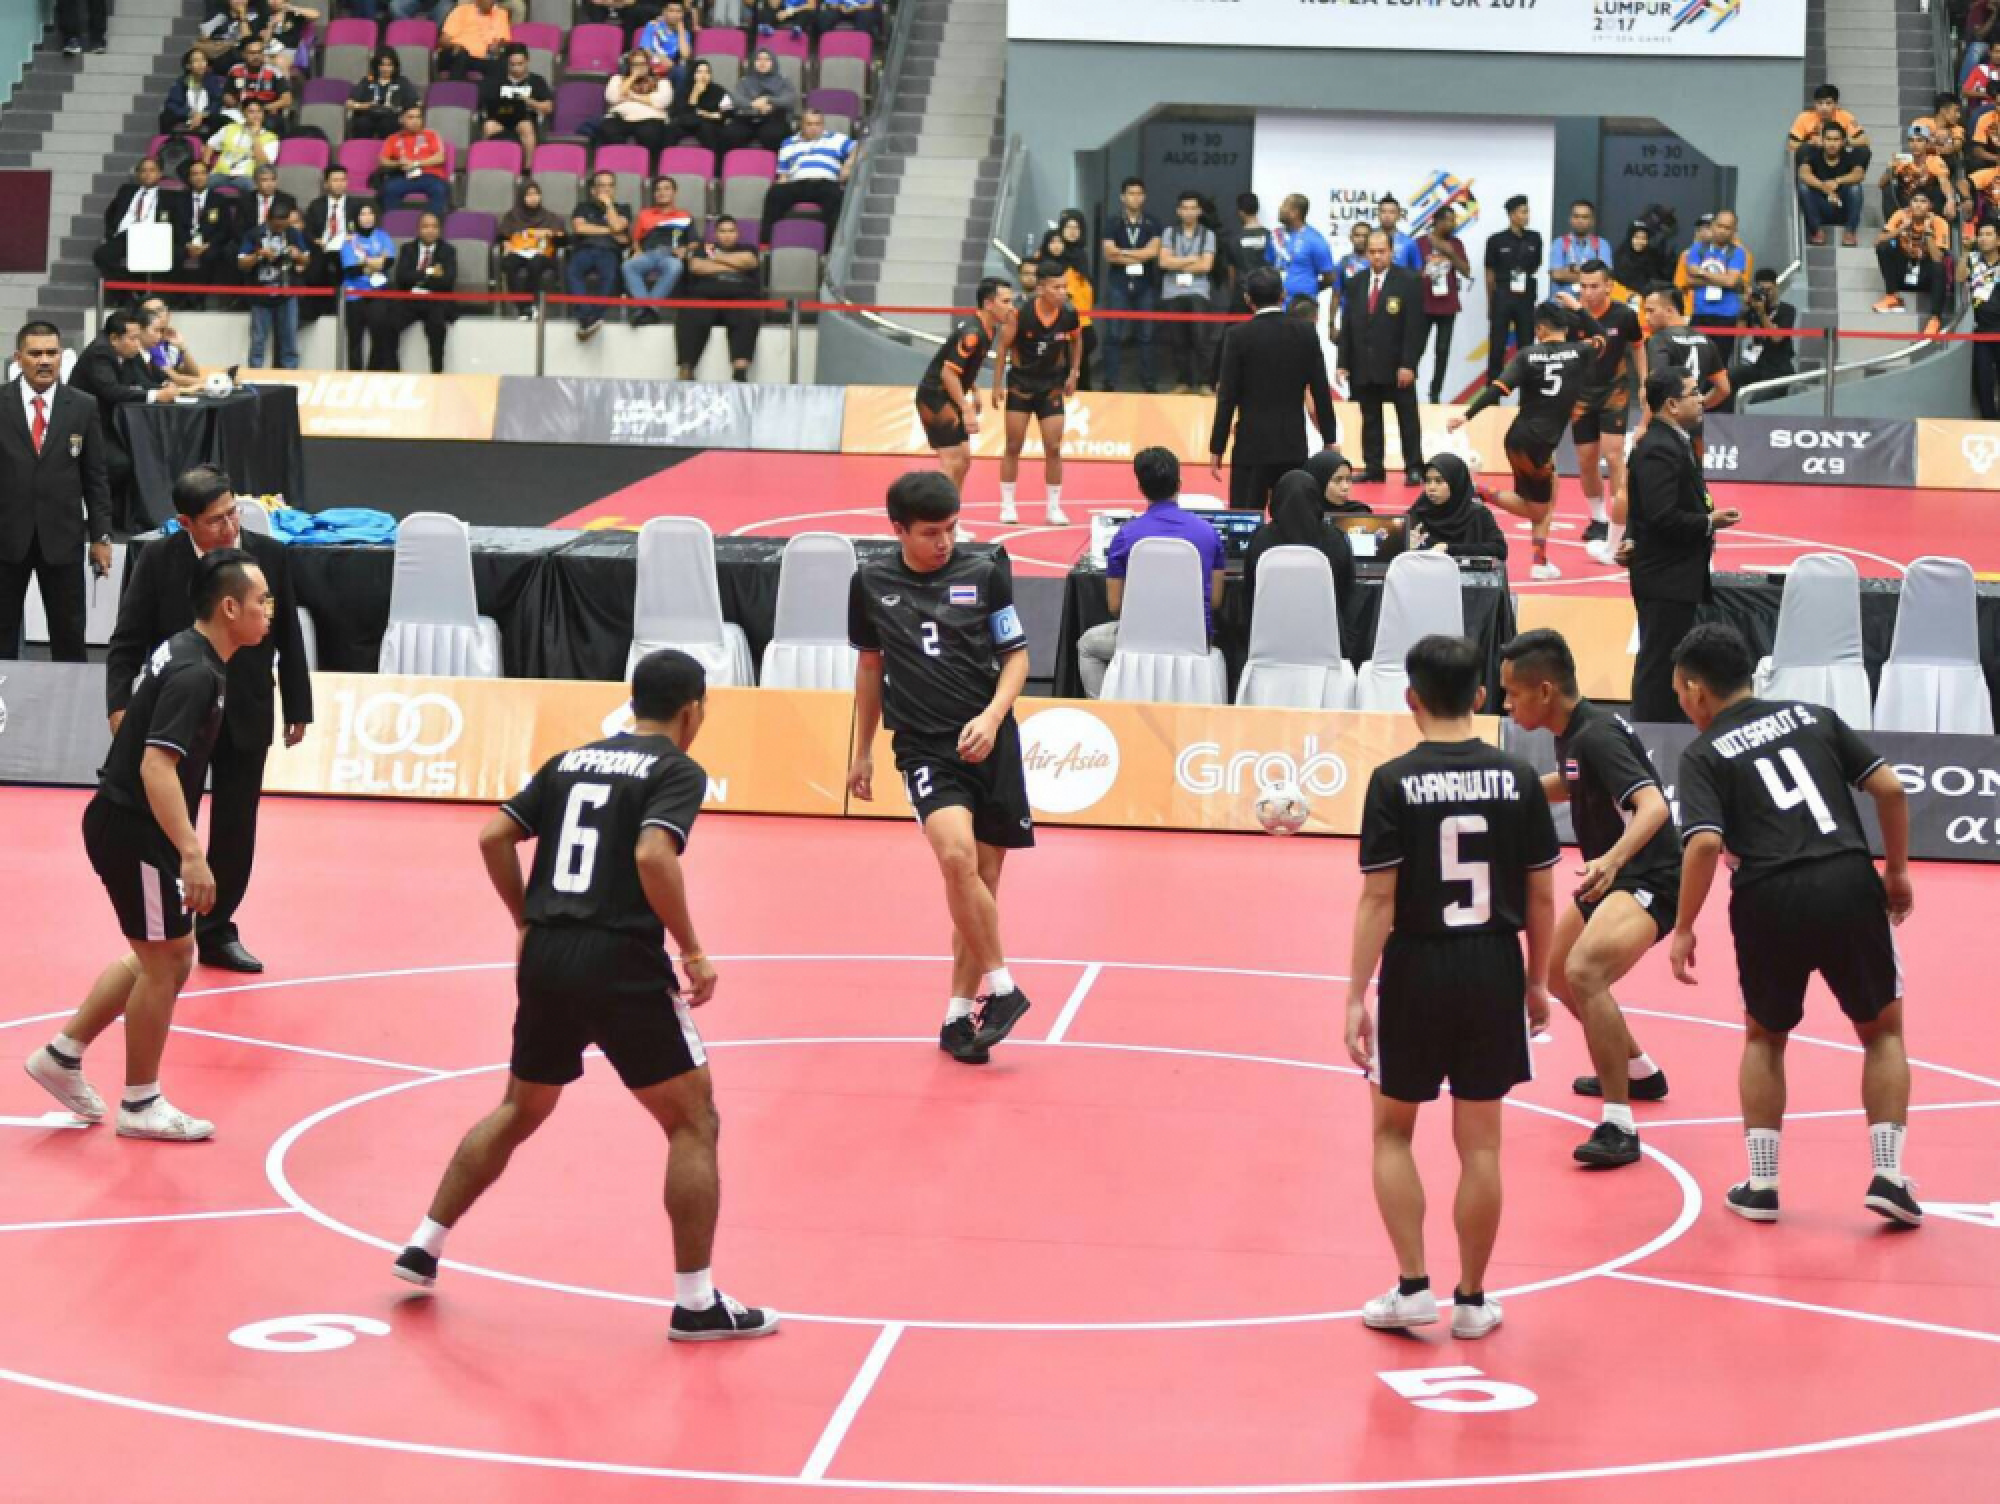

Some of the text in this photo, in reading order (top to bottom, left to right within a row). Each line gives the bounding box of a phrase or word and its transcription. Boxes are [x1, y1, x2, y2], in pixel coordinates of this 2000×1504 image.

[1593, 1, 1672, 15] LUMPUR
[1181, 131, 1223, 148] 19-30
[1641, 143, 1683, 159] 19-30
[1163, 151, 1239, 166] AUG 2017
[1623, 163, 1700, 178] AUG 2017
[1329, 188, 1381, 203] KUAL
[1329, 206, 1409, 222] LUMPR
[1540, 363, 1564, 397] 5
[1769, 429, 1872, 449] SONY
[920, 620, 941, 656] 2
[999, 615, 1011, 635] C
[333, 690, 465, 755] 100
[332, 758, 457, 794] PLUS
[913, 765, 934, 798] 2
[1175, 734, 1349, 798] Grab
[1753, 747, 1839, 835] 4
[552, 782, 613, 893] 6
[1439, 814, 1492, 927] 5
[227, 1312, 393, 1353] 6
[1374, 1365, 1540, 1414] 5
